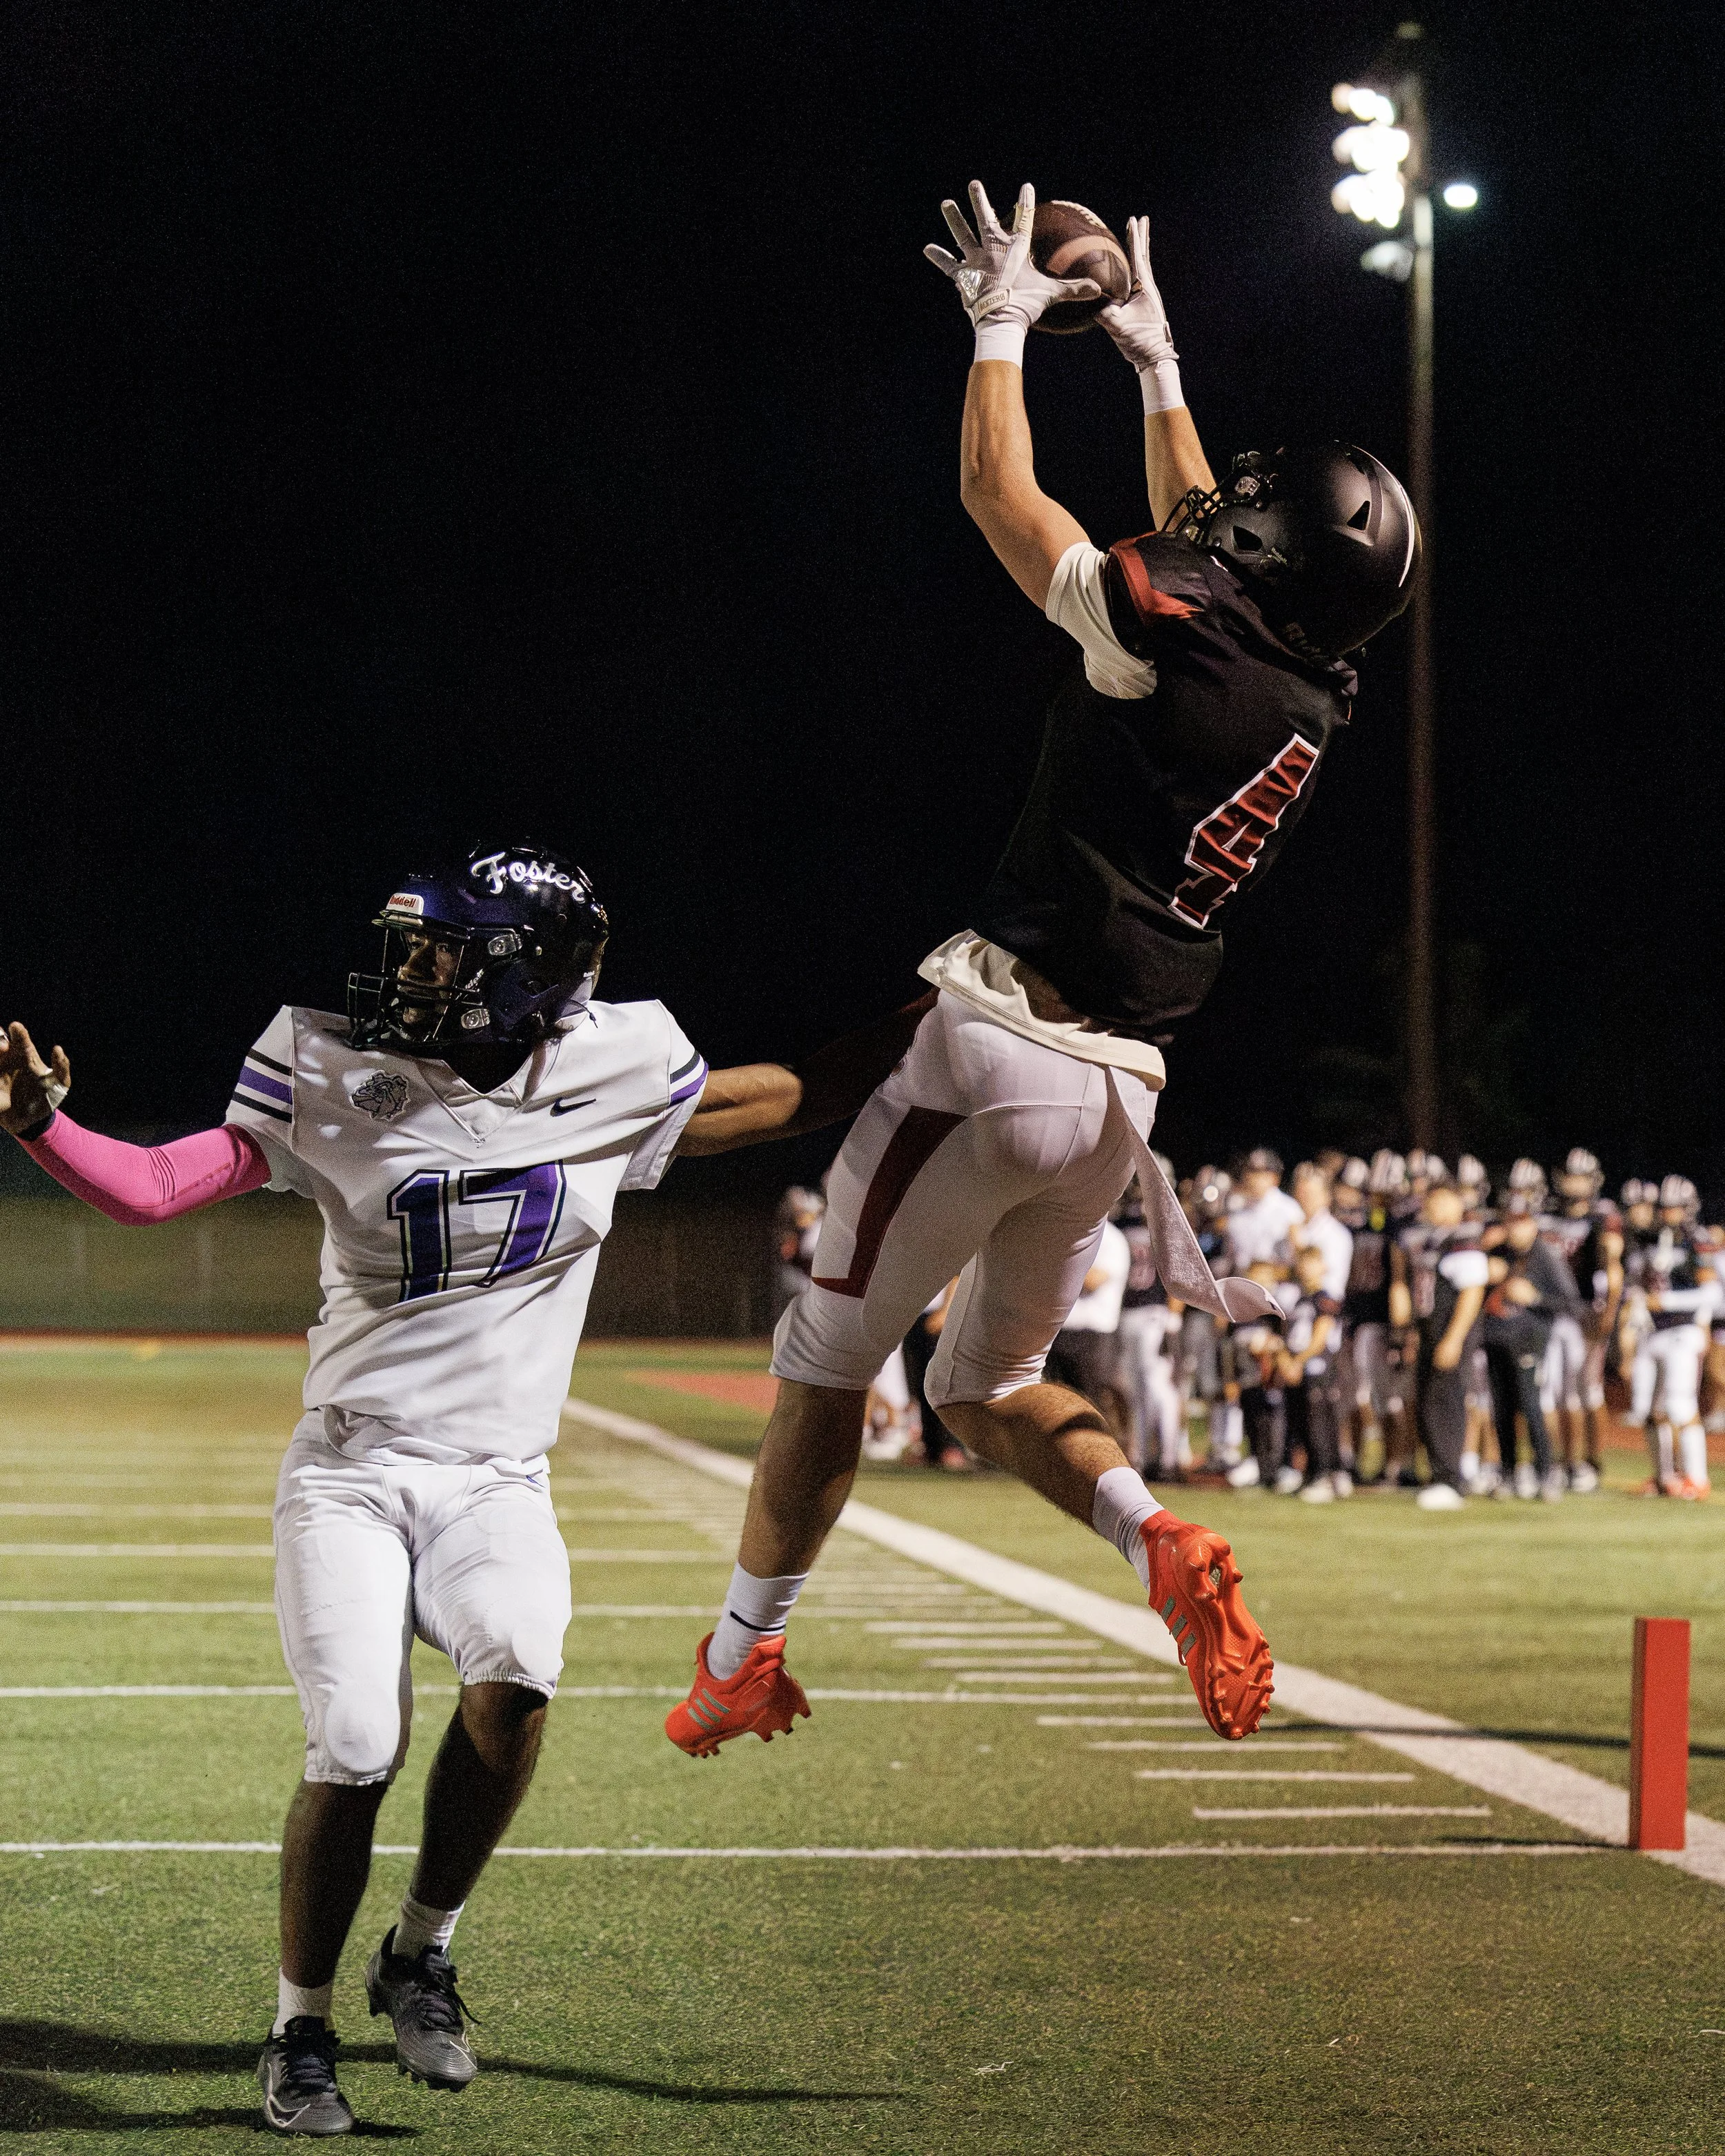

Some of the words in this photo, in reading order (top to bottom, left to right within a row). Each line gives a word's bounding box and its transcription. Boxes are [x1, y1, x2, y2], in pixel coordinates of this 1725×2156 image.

[471, 851, 586, 904] Foster
[1167, 733, 1319, 930] 4
[387, 1159, 567, 1303] 17
